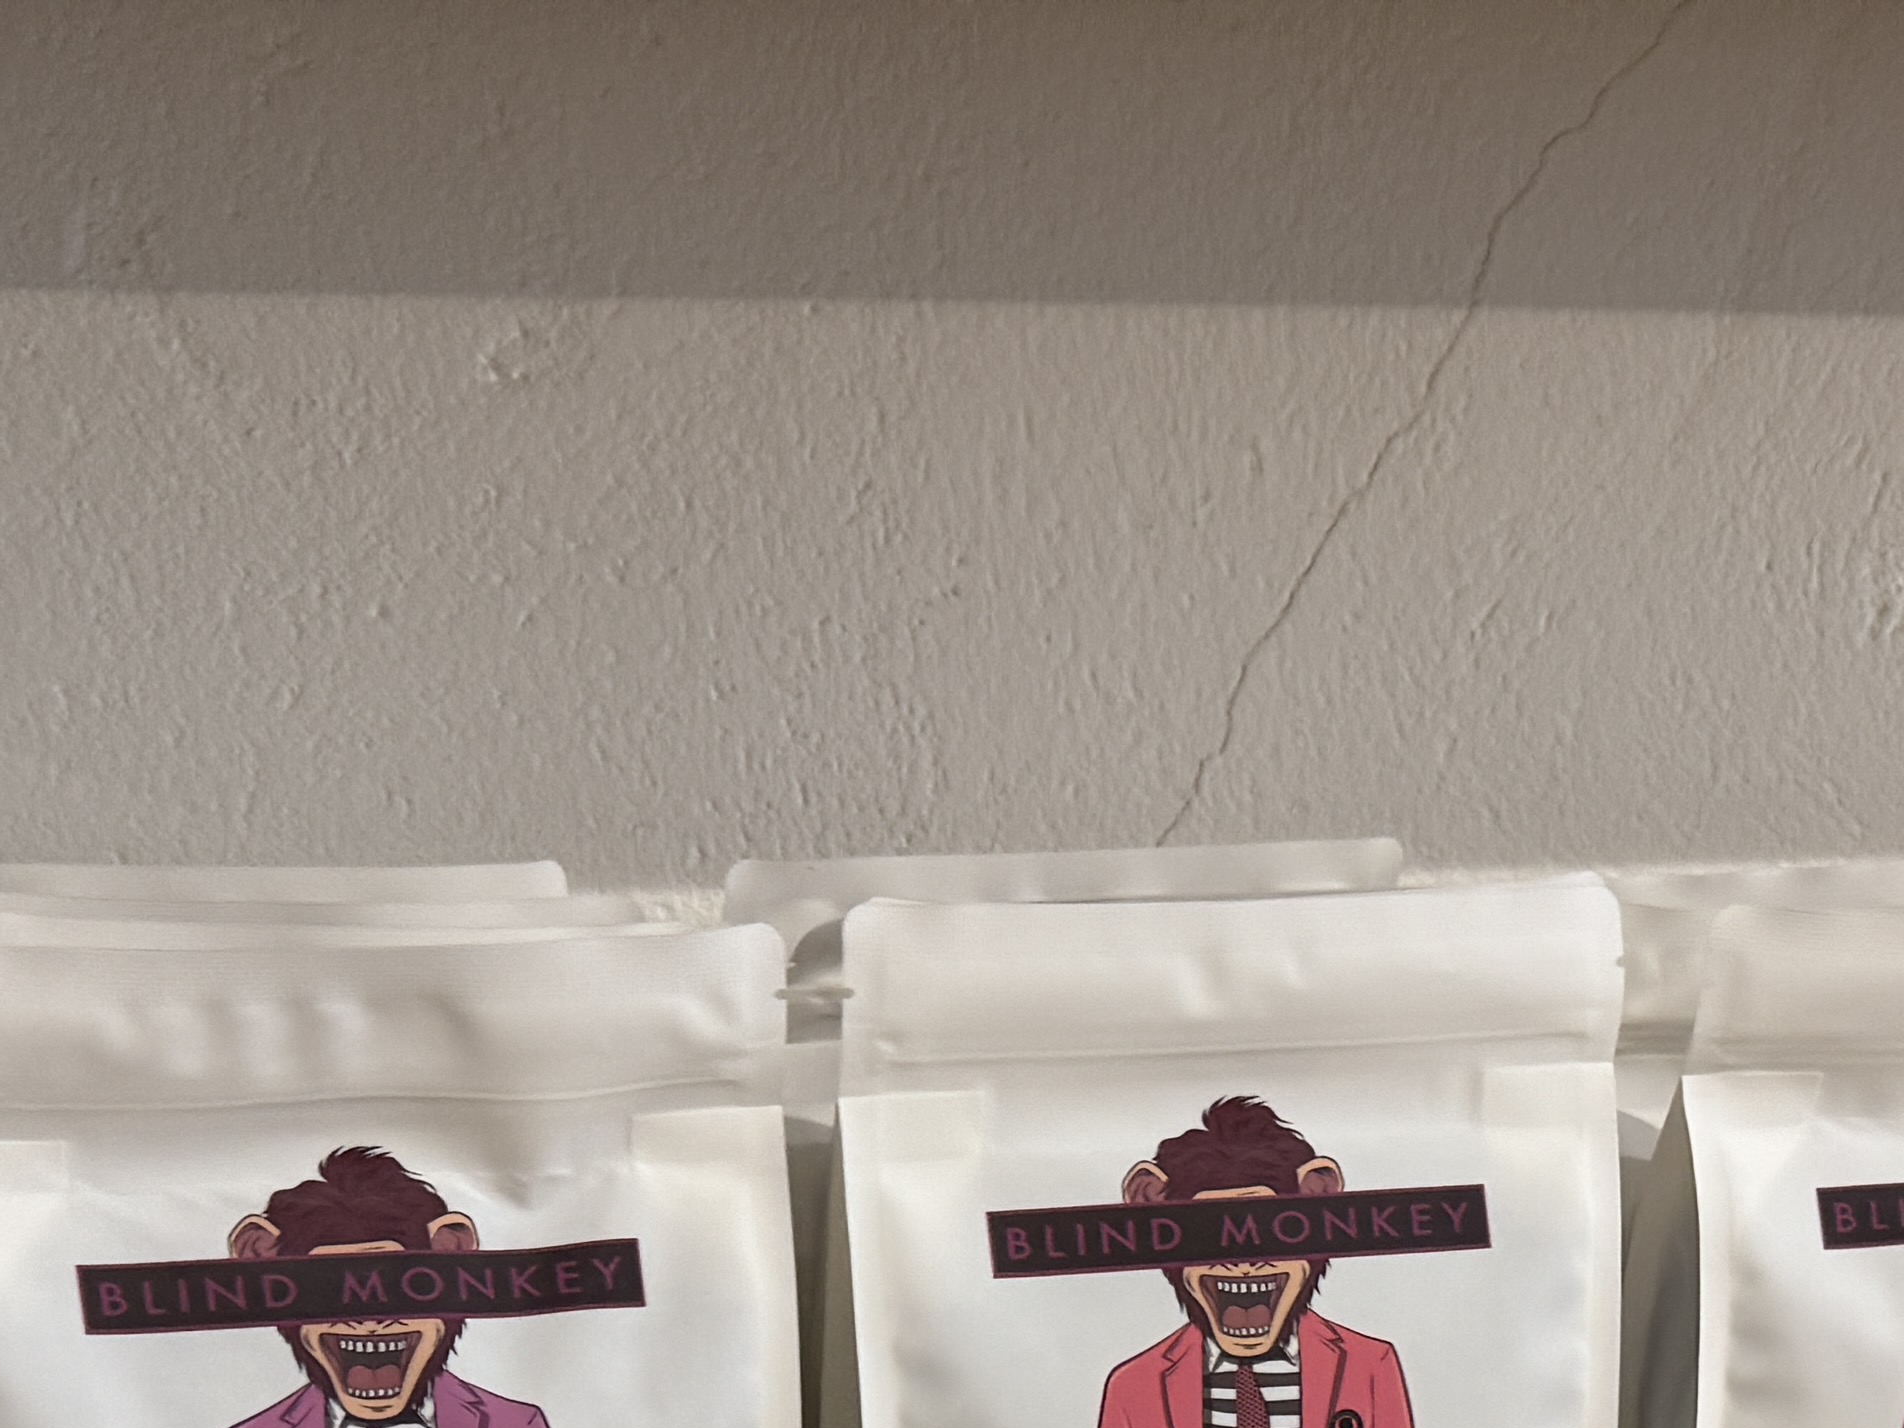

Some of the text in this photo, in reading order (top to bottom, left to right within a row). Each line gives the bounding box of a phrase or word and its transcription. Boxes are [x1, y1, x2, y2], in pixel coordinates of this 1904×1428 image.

[1006, 1202, 1469, 1259] BLIND MONKEY
[98, 1256, 622, 1317] BLIND MONKEY
